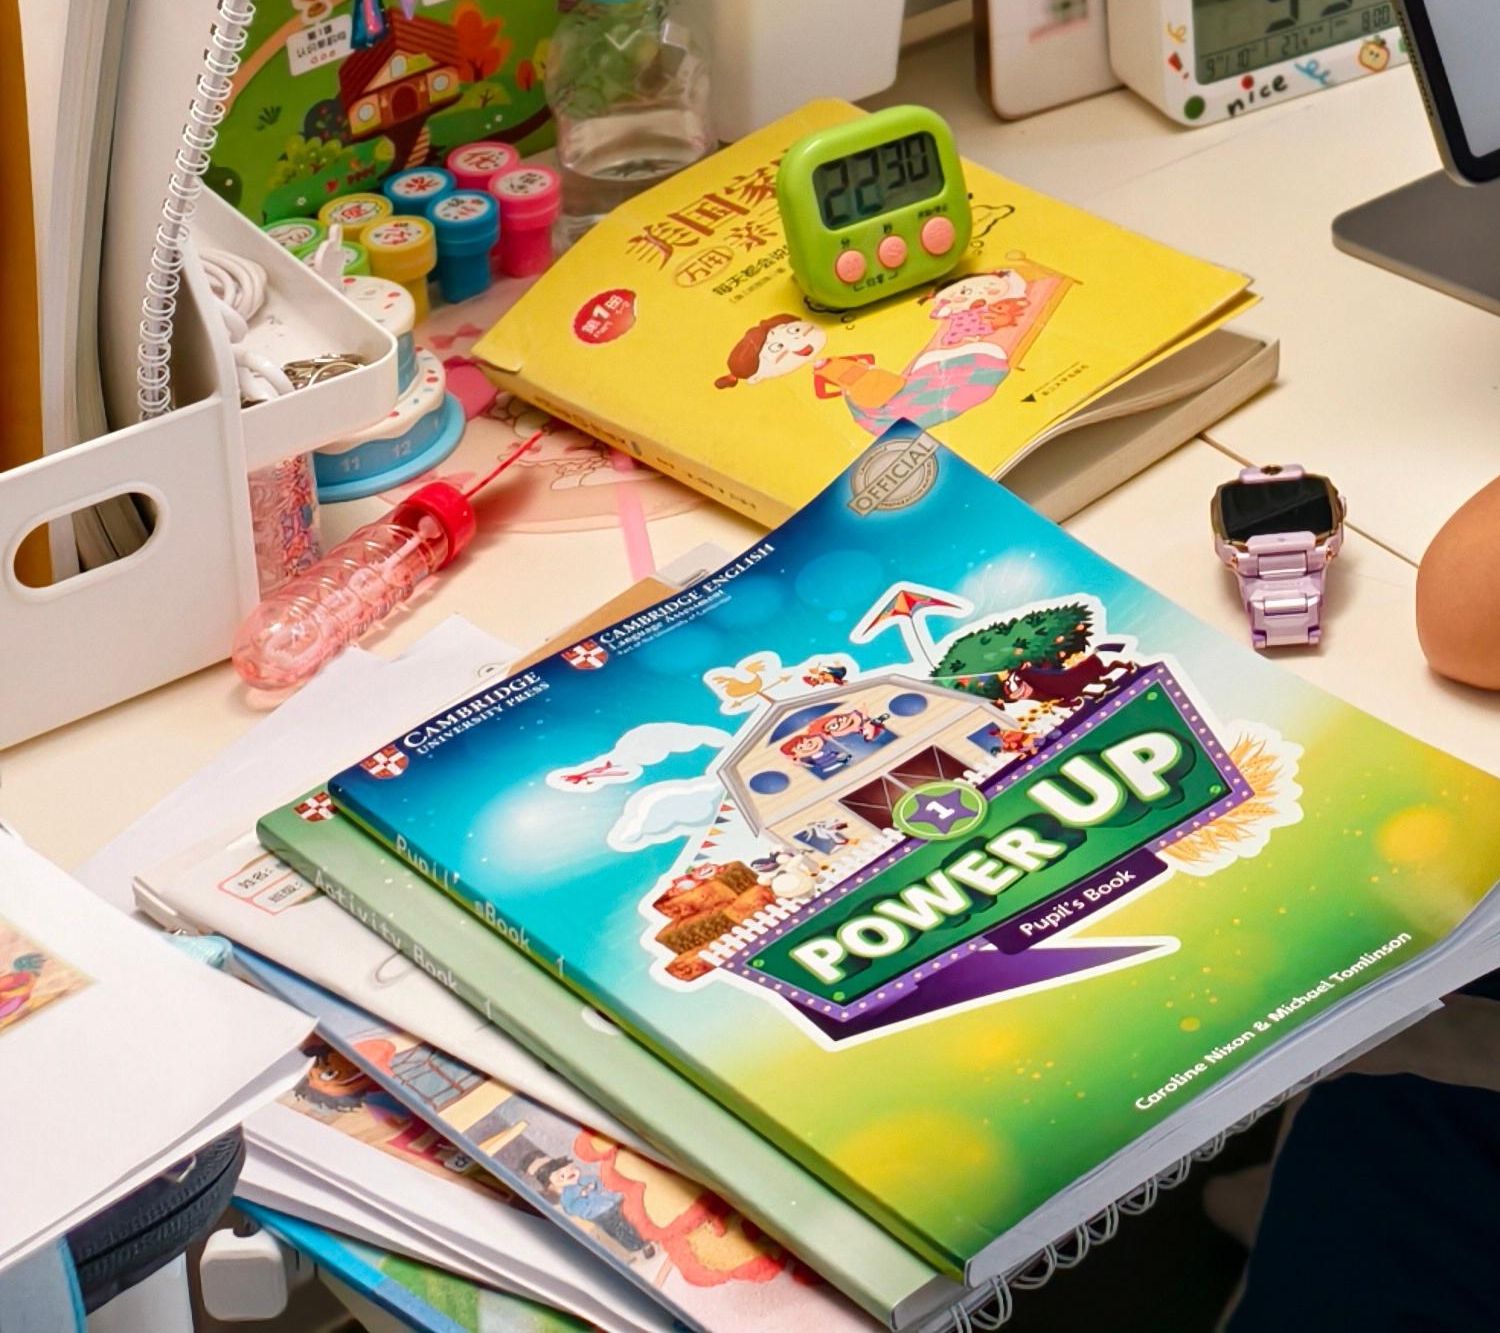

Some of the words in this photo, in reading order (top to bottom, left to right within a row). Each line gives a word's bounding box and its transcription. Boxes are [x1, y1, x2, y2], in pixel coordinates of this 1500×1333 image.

[1227, 75, 1288, 117] nice
[820, 152, 882, 229] 22
[884, 135, 931, 191] 30
[626, 173, 779, 271] 美国家
[712, 245, 789, 295] 每天都会说
[855, 442, 934, 510] OFFICIAL
[600, 589, 702, 644] CAMBRIDGE
[702, 543, 775, 593] ENGLISH
[608, 620, 663, 650] Language
[403, 671, 542, 749] CAMBRIDGE
[416, 707, 504, 755] UNIVERSITY
[505, 681, 551, 708] PRESS
[926, 800, 956, 821] 1
[790, 827, 1066, 985] POWER
[1027, 731, 1183, 827] UP
[314, 870, 401, 953] Activity
[413, 943, 457, 995] Book
[1019, 898, 1085, 937] Pupil's
[1083, 869, 1136, 904] Book
[1135, 1061, 1208, 1111] Caroline
[1204, 1030, 1256, 1064] Nixon
[1253, 1020, 1272, 1033] &
[1268, 980, 1335, 1023] Michael
[1329, 932, 1412, 984] Tomlinson
